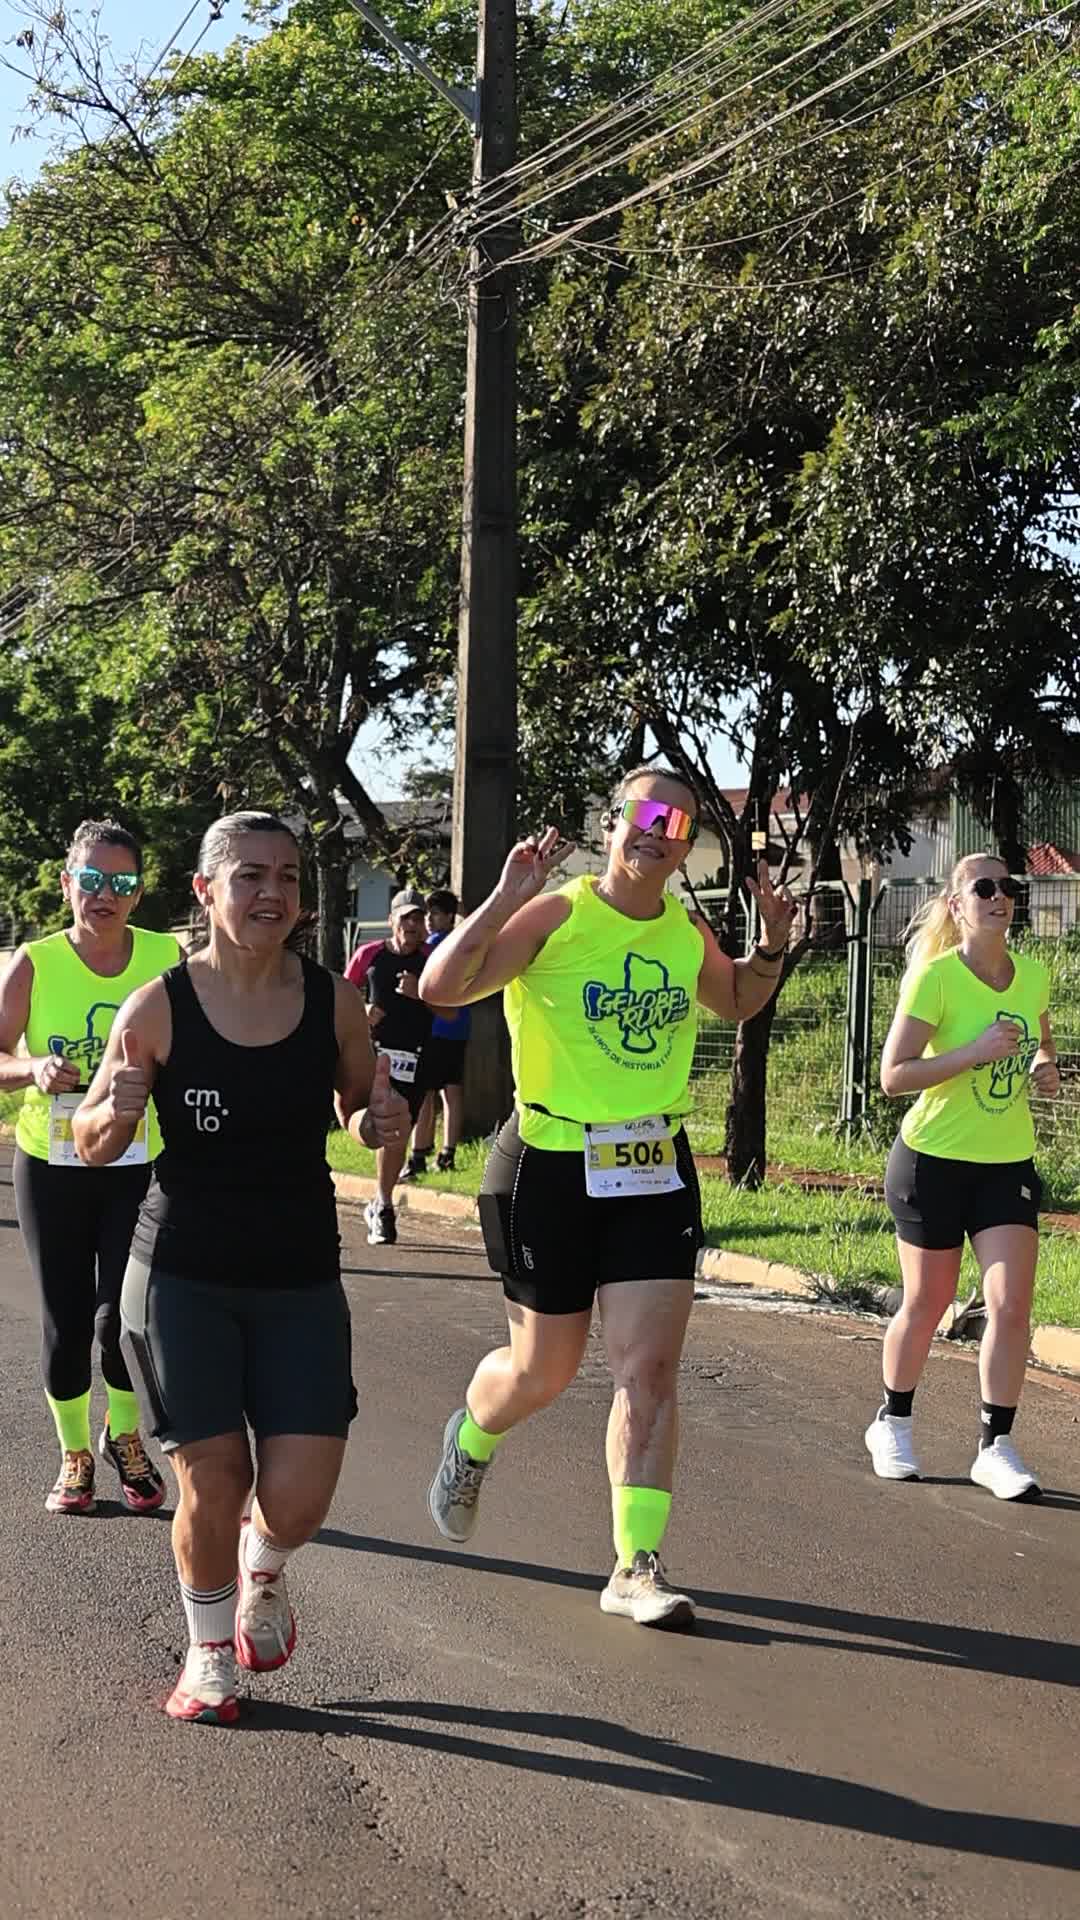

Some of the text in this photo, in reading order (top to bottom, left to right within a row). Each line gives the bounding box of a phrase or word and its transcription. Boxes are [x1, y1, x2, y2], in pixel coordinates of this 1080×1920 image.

[596, 988, 688, 1016] GELOBEL
[621, 1005, 671, 1034] RUN
[184, 1088, 221, 1107] cm
[615, 1140, 664, 1168] 506
